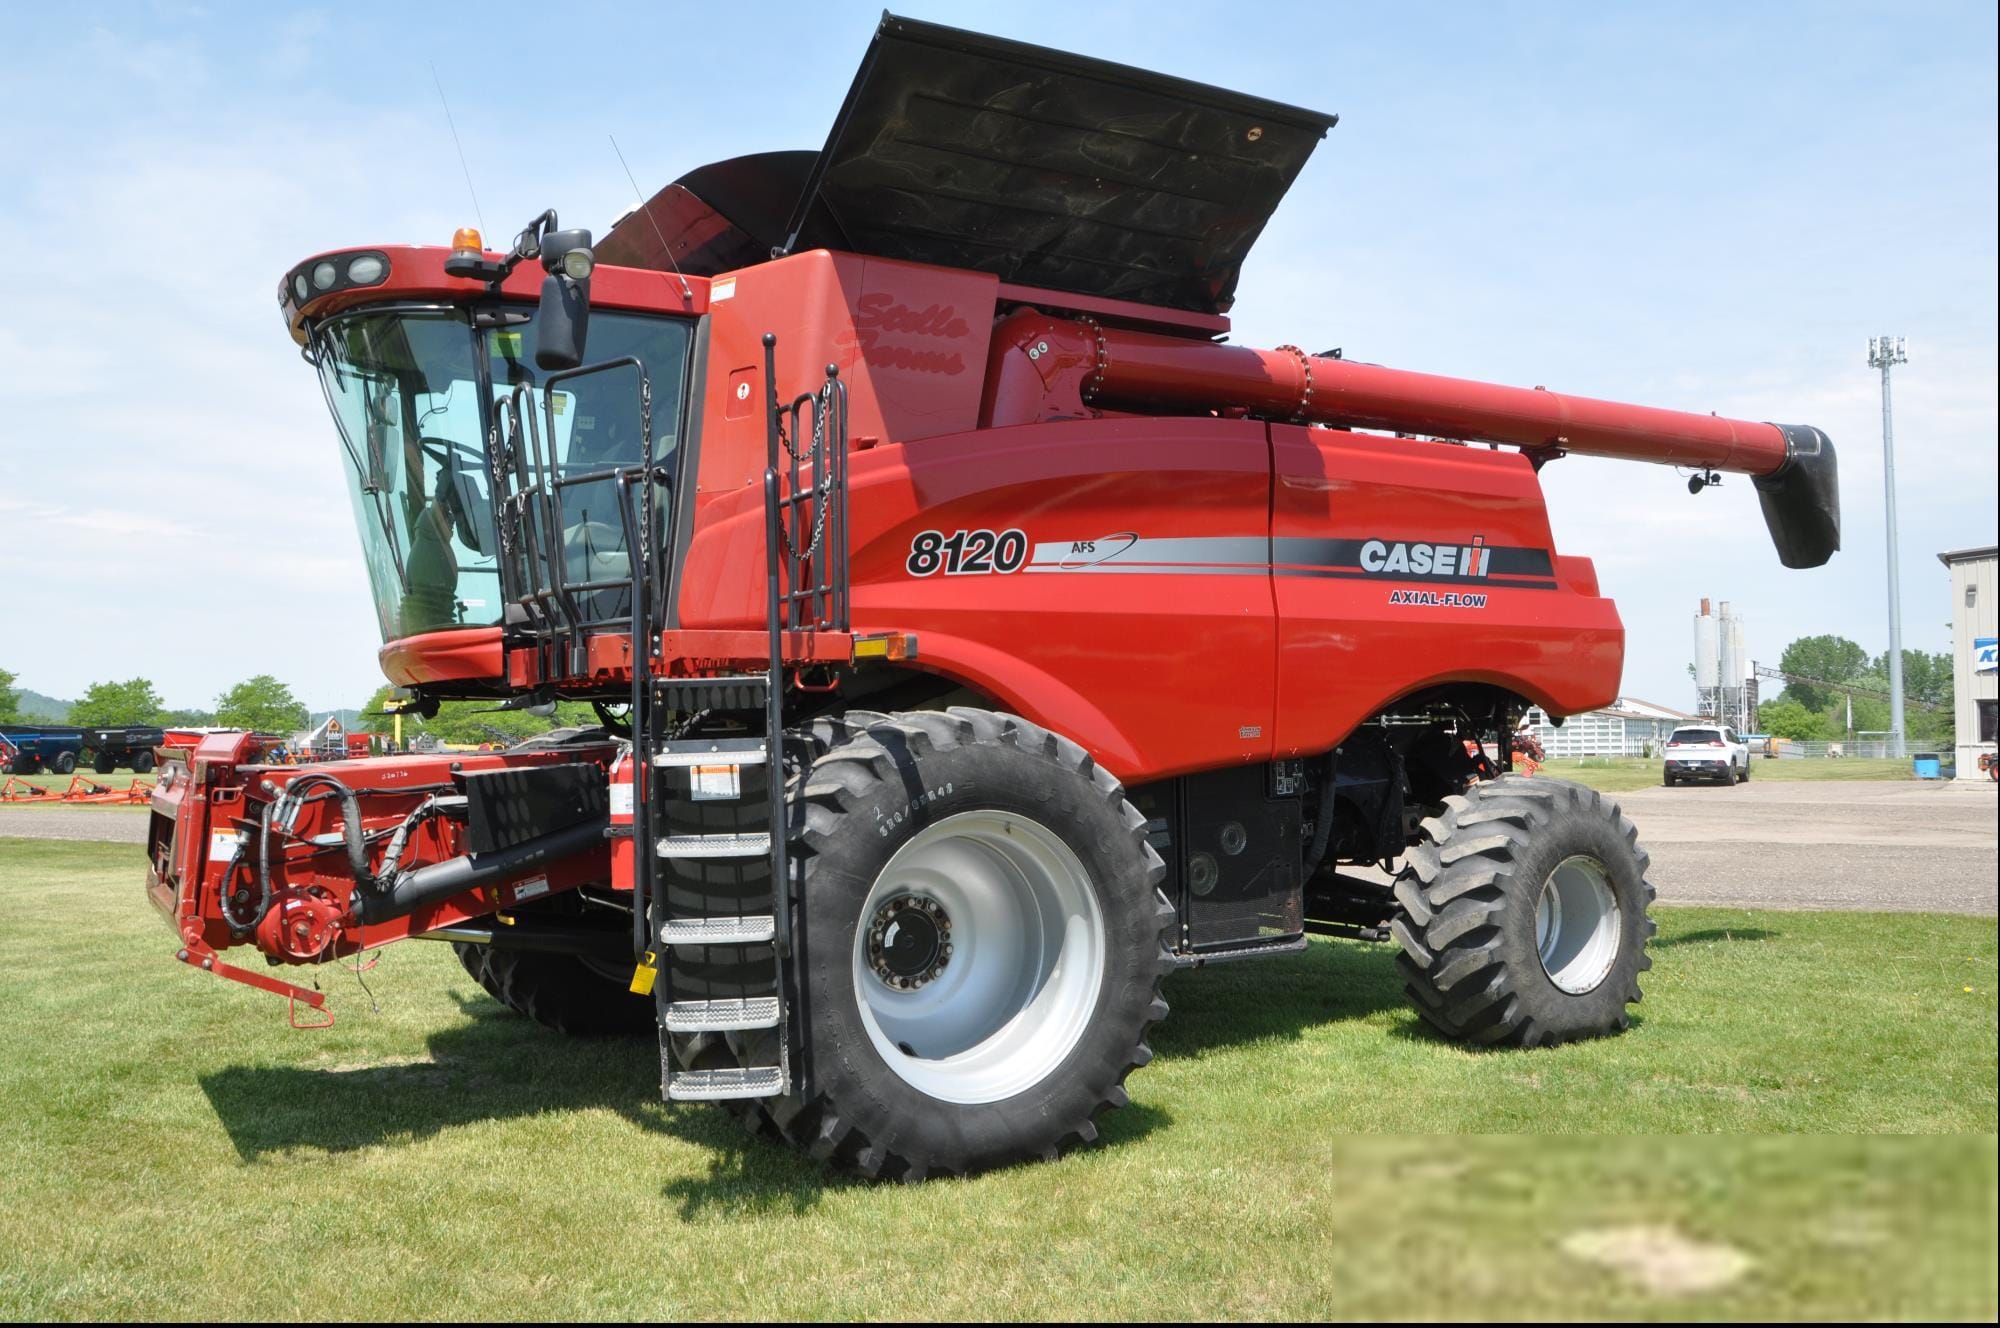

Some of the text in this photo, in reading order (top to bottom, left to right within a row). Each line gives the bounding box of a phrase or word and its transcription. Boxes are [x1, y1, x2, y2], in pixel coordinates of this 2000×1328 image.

[906, 528, 1028, 577] 8120
[1071, 541, 1096, 554] AFS
[1360, 540, 1458, 576] CASE
[1388, 589, 1488, 609] AXIAL-FLOW
